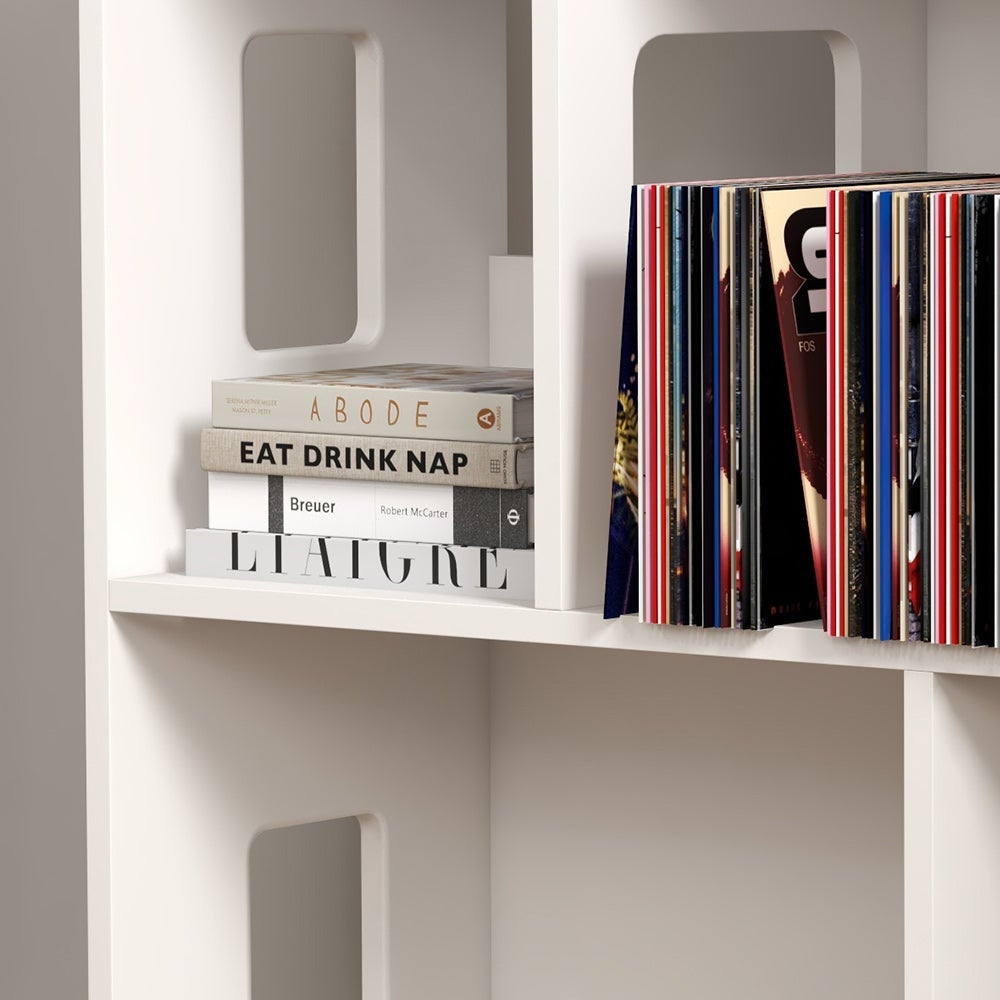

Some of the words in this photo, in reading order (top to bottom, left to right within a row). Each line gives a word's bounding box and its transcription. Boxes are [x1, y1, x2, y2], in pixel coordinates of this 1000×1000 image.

[311, 396, 429, 428] ABODE
[240, 441, 294, 466] EAT
[303, 445, 398, 472] DRINK
[406, 450, 469, 475] NAP
[290, 497, 336, 514] Breuer
[380, 505, 409, 518] Robert
[410, 506, 449, 520] McCarter
